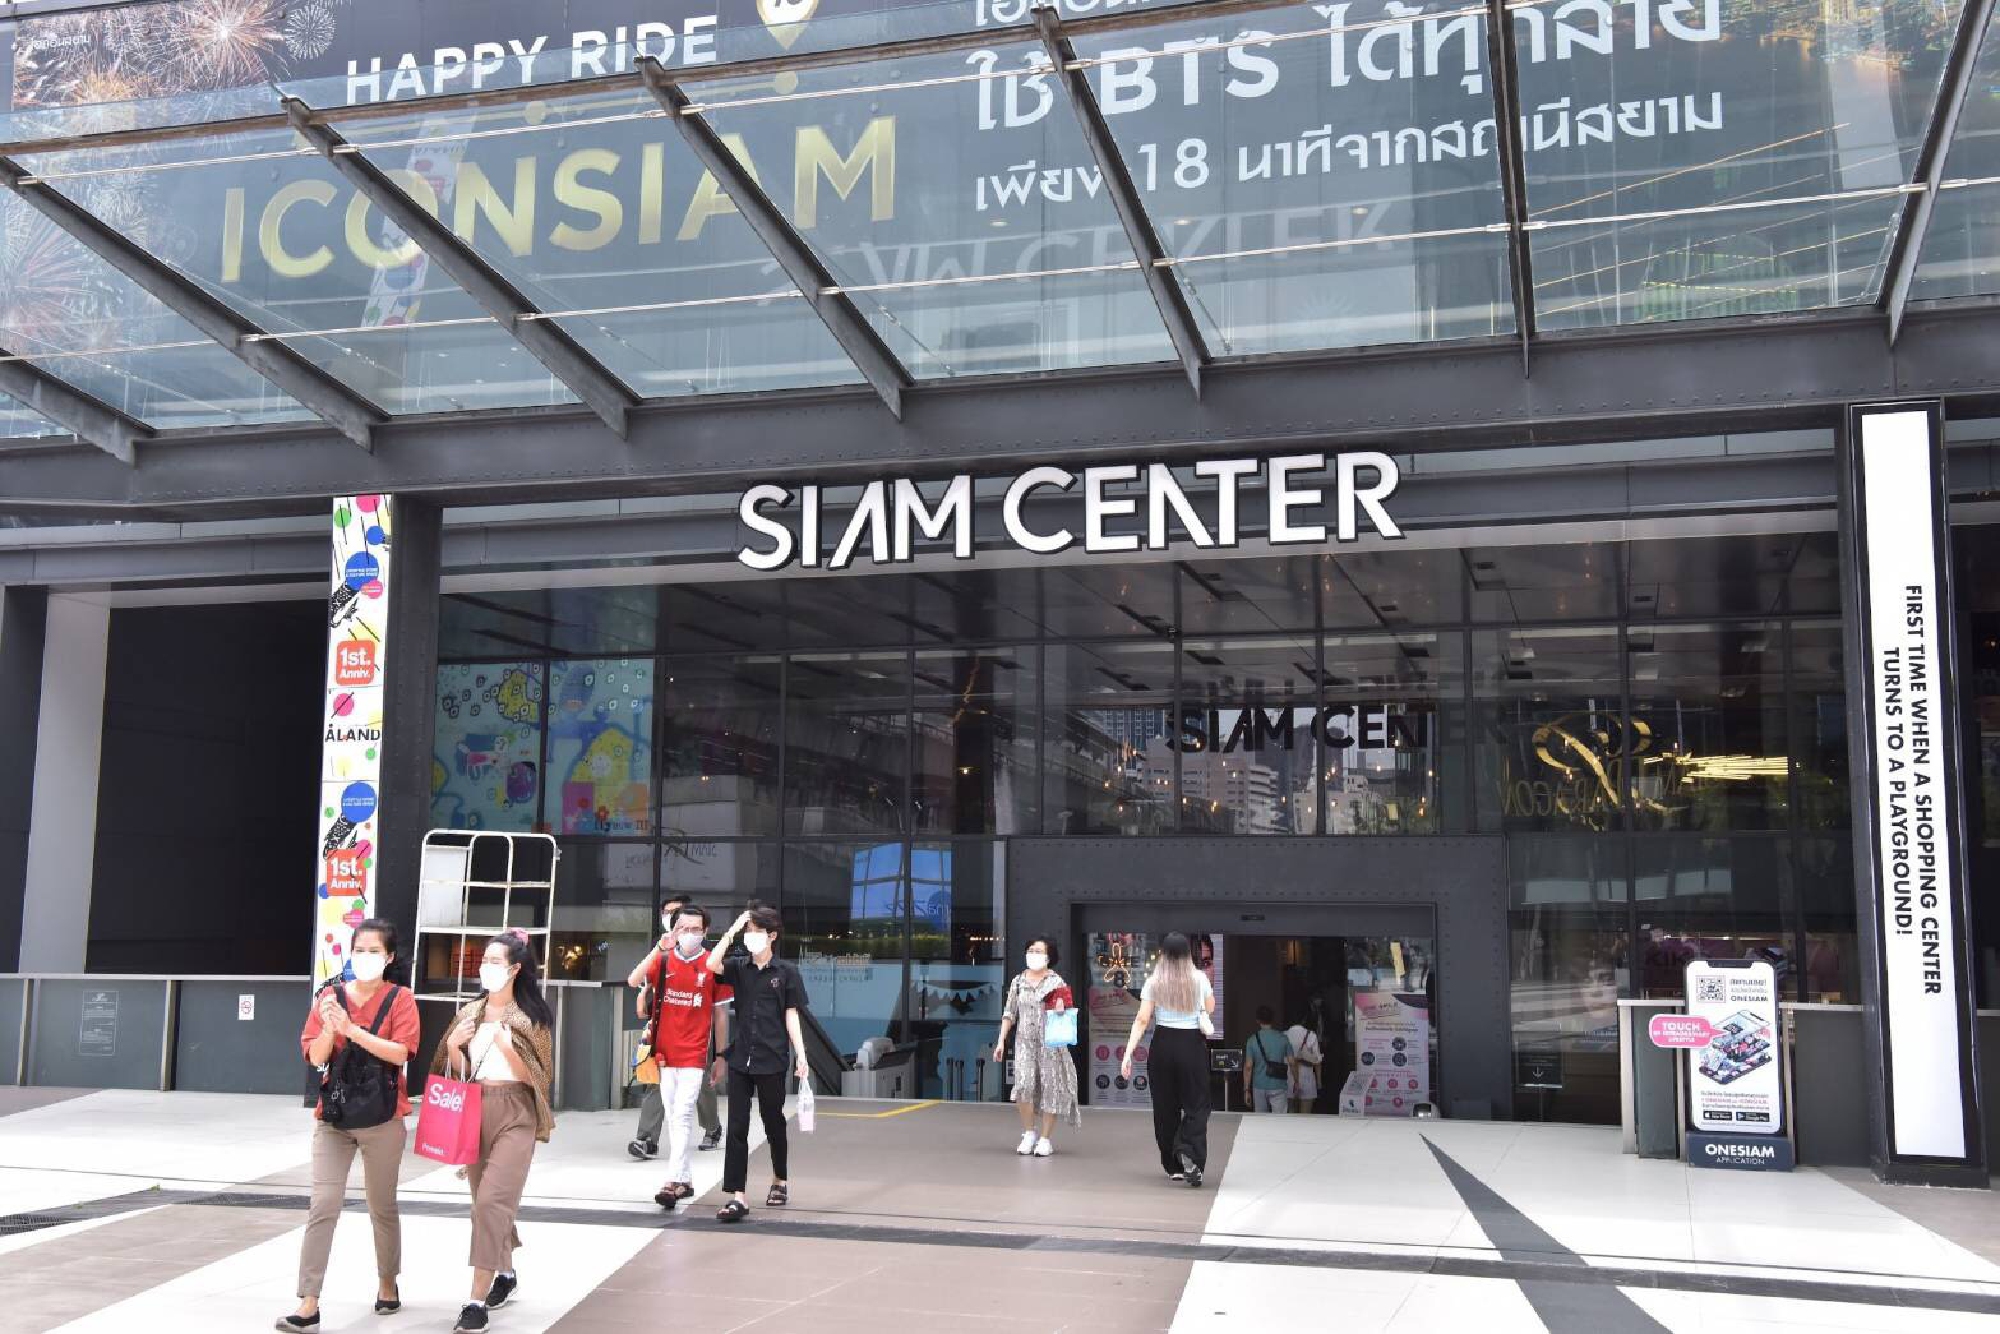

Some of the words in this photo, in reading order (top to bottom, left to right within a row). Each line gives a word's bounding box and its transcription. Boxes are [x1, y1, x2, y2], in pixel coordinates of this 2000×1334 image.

[346, 35, 548, 105] HAPPY
[571, 14, 718, 79] RIDE
[1099, 30, 1280, 116] BTS
[1137, 138, 1210, 191] 18
[220, 116, 897, 283] ICONSIAM
[738, 475, 972, 570] SIAM
[1003, 452, 1402, 552] CENTER
[1906, 585, 1924, 638] FIRST
[1883, 647, 1903, 716] TURNS
[1908, 644, 1927, 692] TIME
[1887, 723, 1904, 750] TO
[1911, 699, 1930, 764] WHEN
[1888, 757, 1905, 773] A
[1914, 773, 1931, 787] A
[1889, 780, 1913, 935] PLAYGROUND!
[1915, 794, 1938, 909] SHOPPING
[1921, 917, 1942, 994] CENTER
[1662, 1022, 1700, 1031] TOUCH
[428, 1083, 467, 1113] Sale!
[1704, 1143, 1775, 1158] ONESIAM
[1716, 1157, 1765, 1165] APPLICATION
